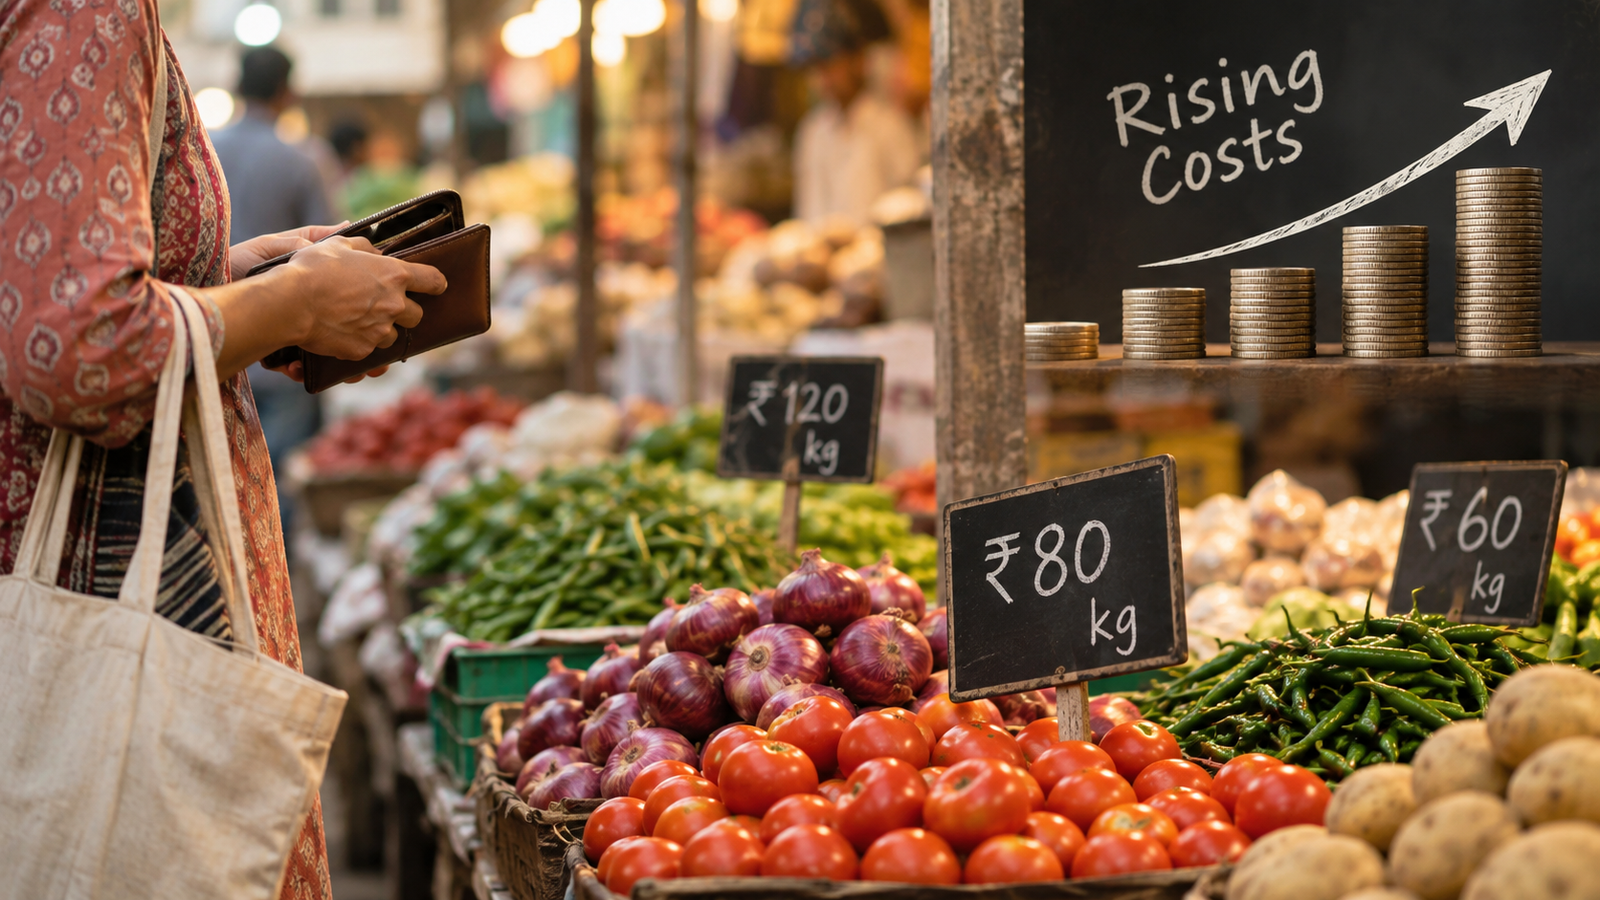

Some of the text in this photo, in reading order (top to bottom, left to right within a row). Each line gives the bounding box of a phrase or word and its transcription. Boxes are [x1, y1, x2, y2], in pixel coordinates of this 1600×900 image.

[1107, 49, 1324, 147] Rising
[1141, 118, 1304, 205] Costs
[803, 429, 840, 476] kg
[1471, 560, 1505, 614] kg
[1091, 597, 1137, 656] kg
